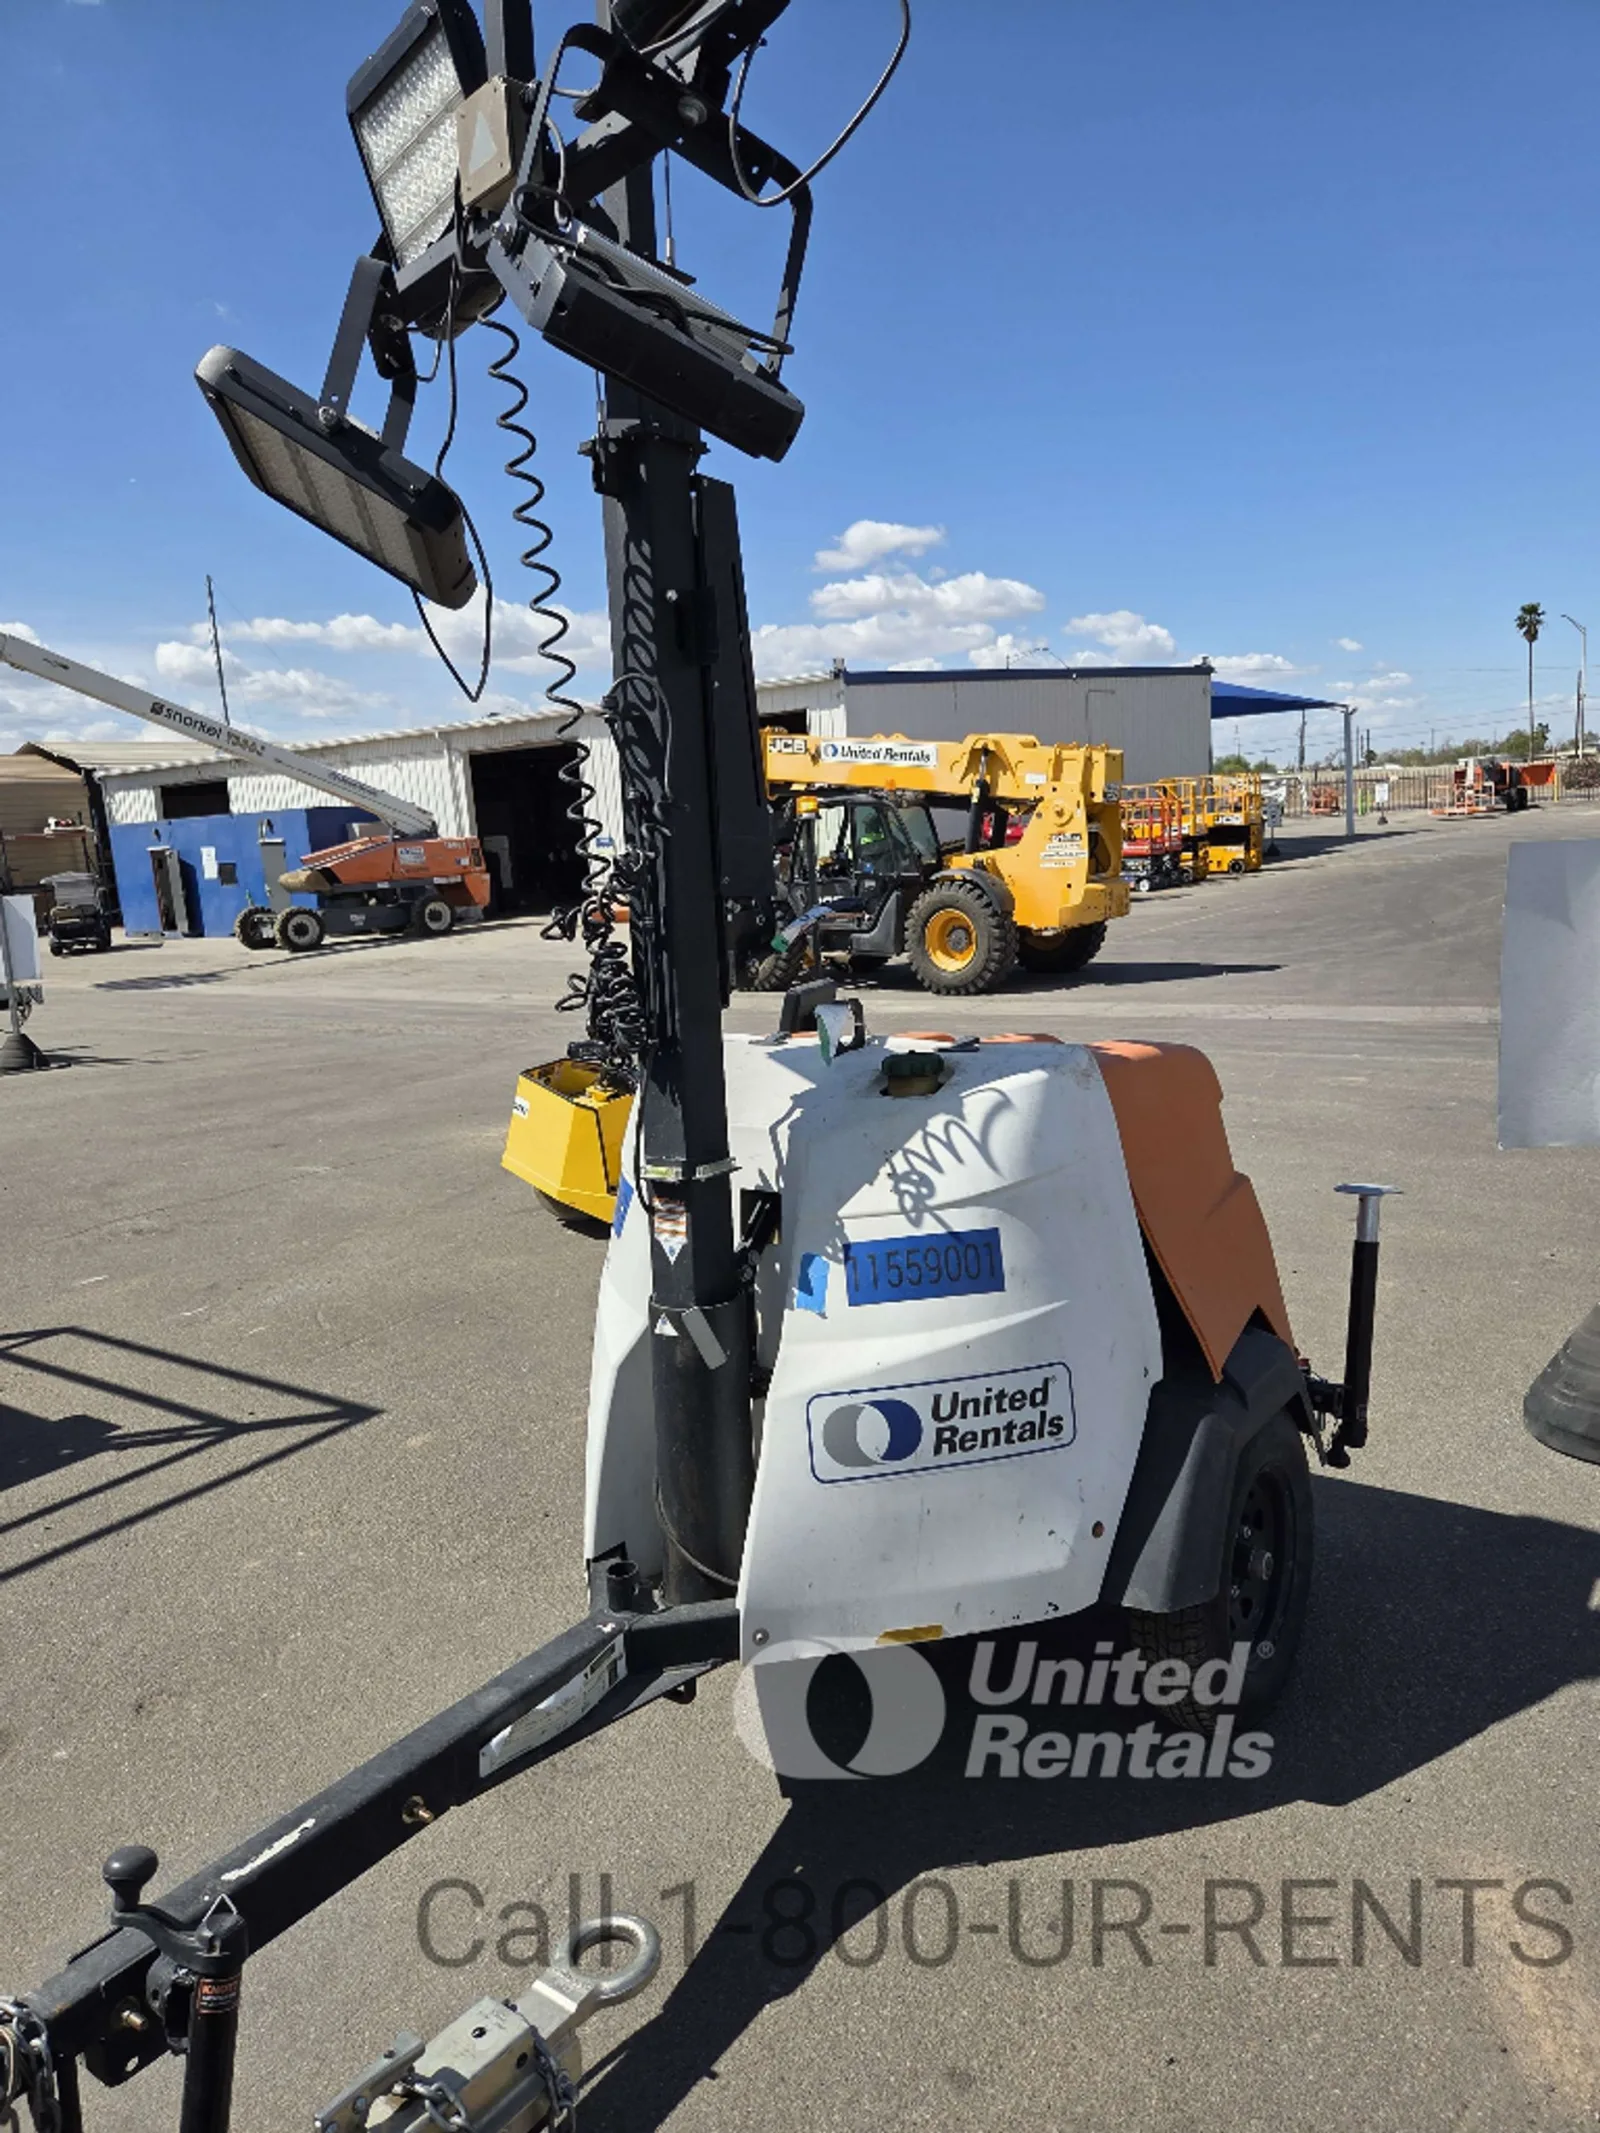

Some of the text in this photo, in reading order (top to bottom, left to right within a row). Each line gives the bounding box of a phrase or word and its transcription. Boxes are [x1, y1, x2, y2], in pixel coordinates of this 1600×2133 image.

[164, 707, 222, 739] snorkel
[769, 738, 806, 754] JCB
[841, 745, 931, 762] United Rentals
[847, 1242, 997, 1293] 11559001
[933, 1410, 1064, 1456] Rentals
